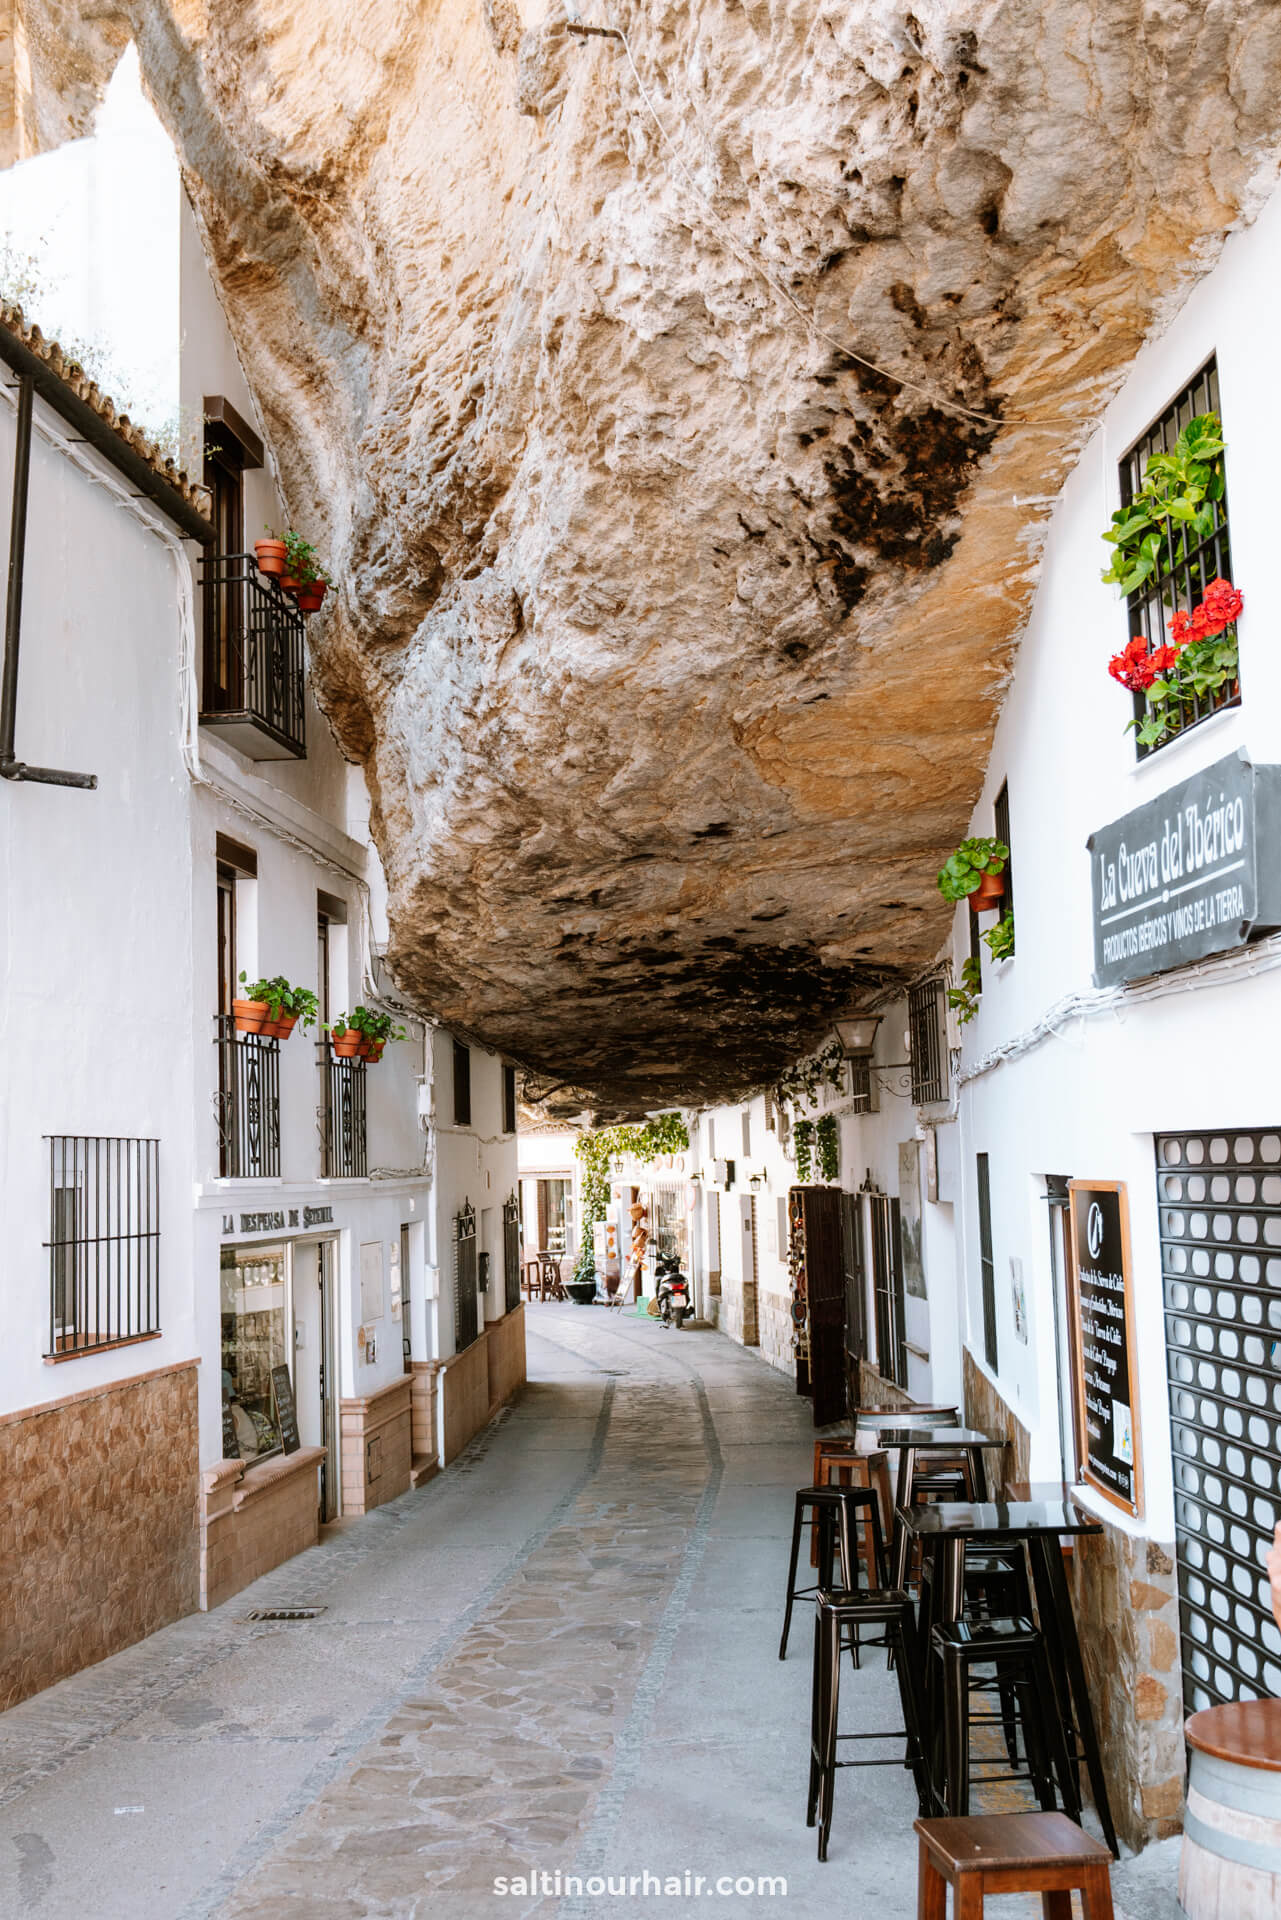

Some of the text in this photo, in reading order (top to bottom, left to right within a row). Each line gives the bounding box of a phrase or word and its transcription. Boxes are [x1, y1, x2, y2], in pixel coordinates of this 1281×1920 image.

[1101, 793, 1244, 911] La Cueva del Ibérico
[1103, 884, 1245, 965] PRODUCTOS IBÉRICOS Y VINOS DE LA TIERRA
[222, 1214, 234, 1234] LA
[240, 1210, 285, 1233] DESPENSA
[288, 1209, 299, 1228] DE
